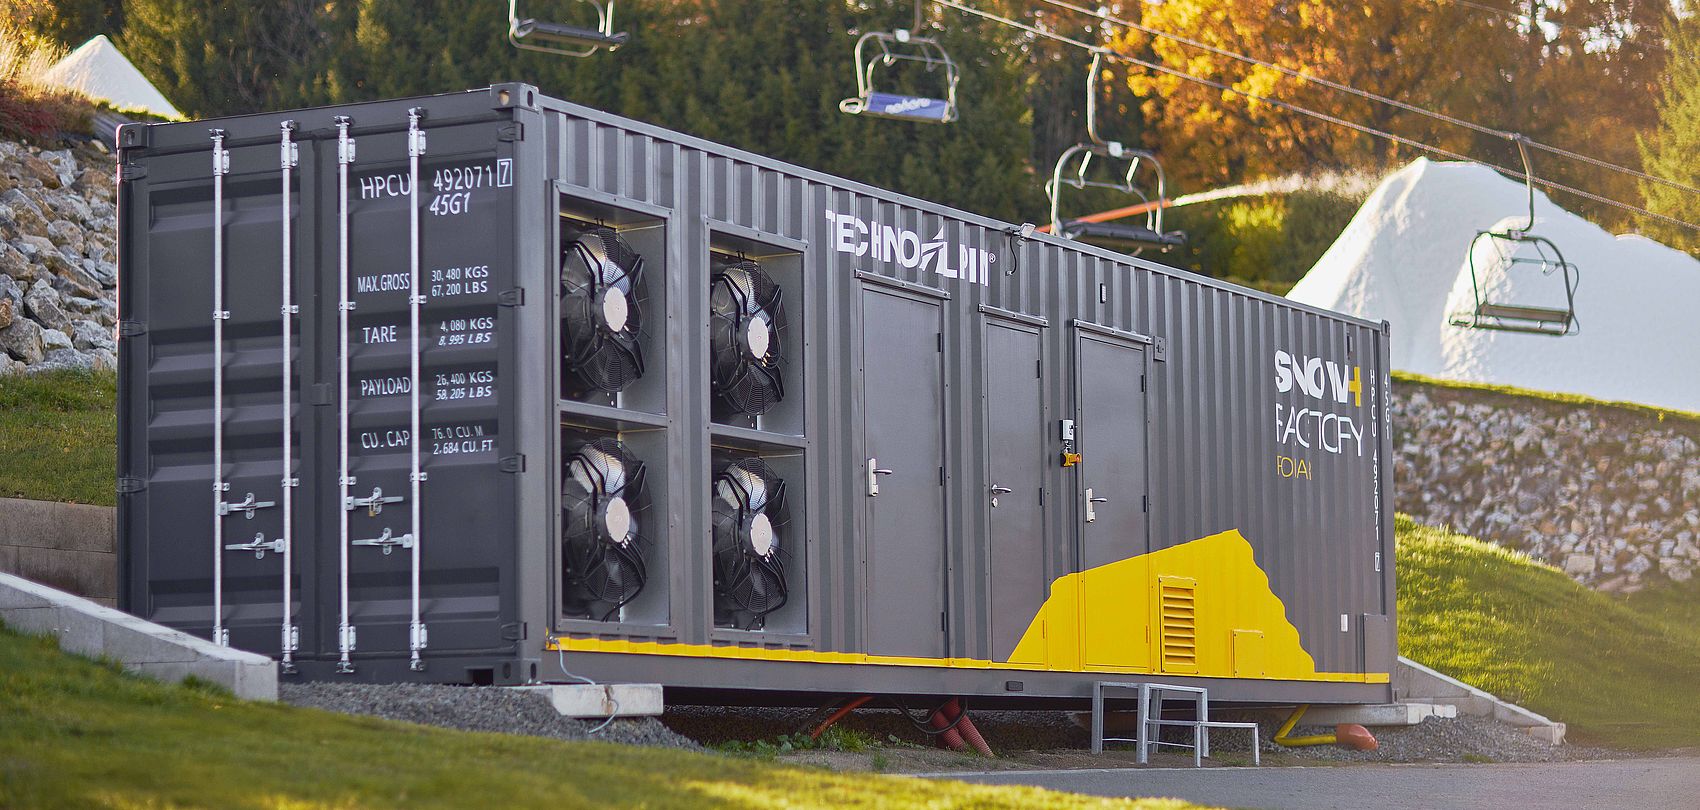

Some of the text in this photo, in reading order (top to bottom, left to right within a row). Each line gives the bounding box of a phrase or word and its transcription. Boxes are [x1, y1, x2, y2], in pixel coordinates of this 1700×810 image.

[360, 173, 411, 199] HPCU
[433, 165, 493, 191] 492071
[429, 192, 471, 216] 45G1
[465, 265, 489, 279] KGS
[465, 280, 488, 294] LBS
[469, 317, 494, 330] KGS
[362, 325, 397, 344] TARE
[468, 332, 492, 344] LBS
[468, 370, 494, 384] KGS
[360, 376, 411, 396] PAYLOAD
[468, 385, 493, 398] LBS
[475, 425, 484, 437] M
[481, 439, 494, 452] FT
